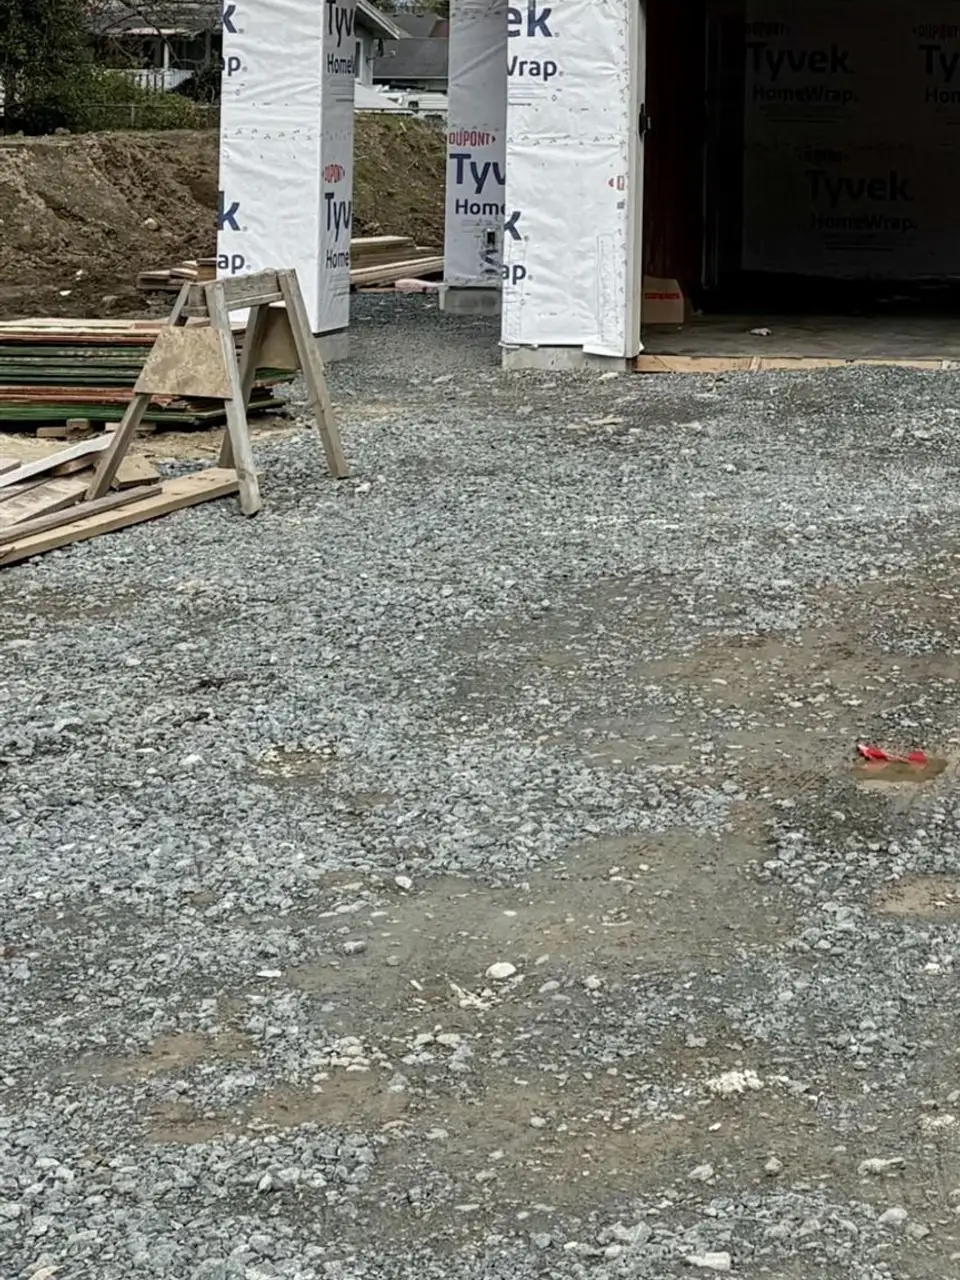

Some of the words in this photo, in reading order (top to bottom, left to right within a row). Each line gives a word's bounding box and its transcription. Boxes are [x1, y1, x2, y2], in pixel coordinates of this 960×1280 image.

[747, 42, 850, 81] Tyvek
[449, 131, 490, 147] DUPONT
[805, 170, 910, 207] Tyvek
